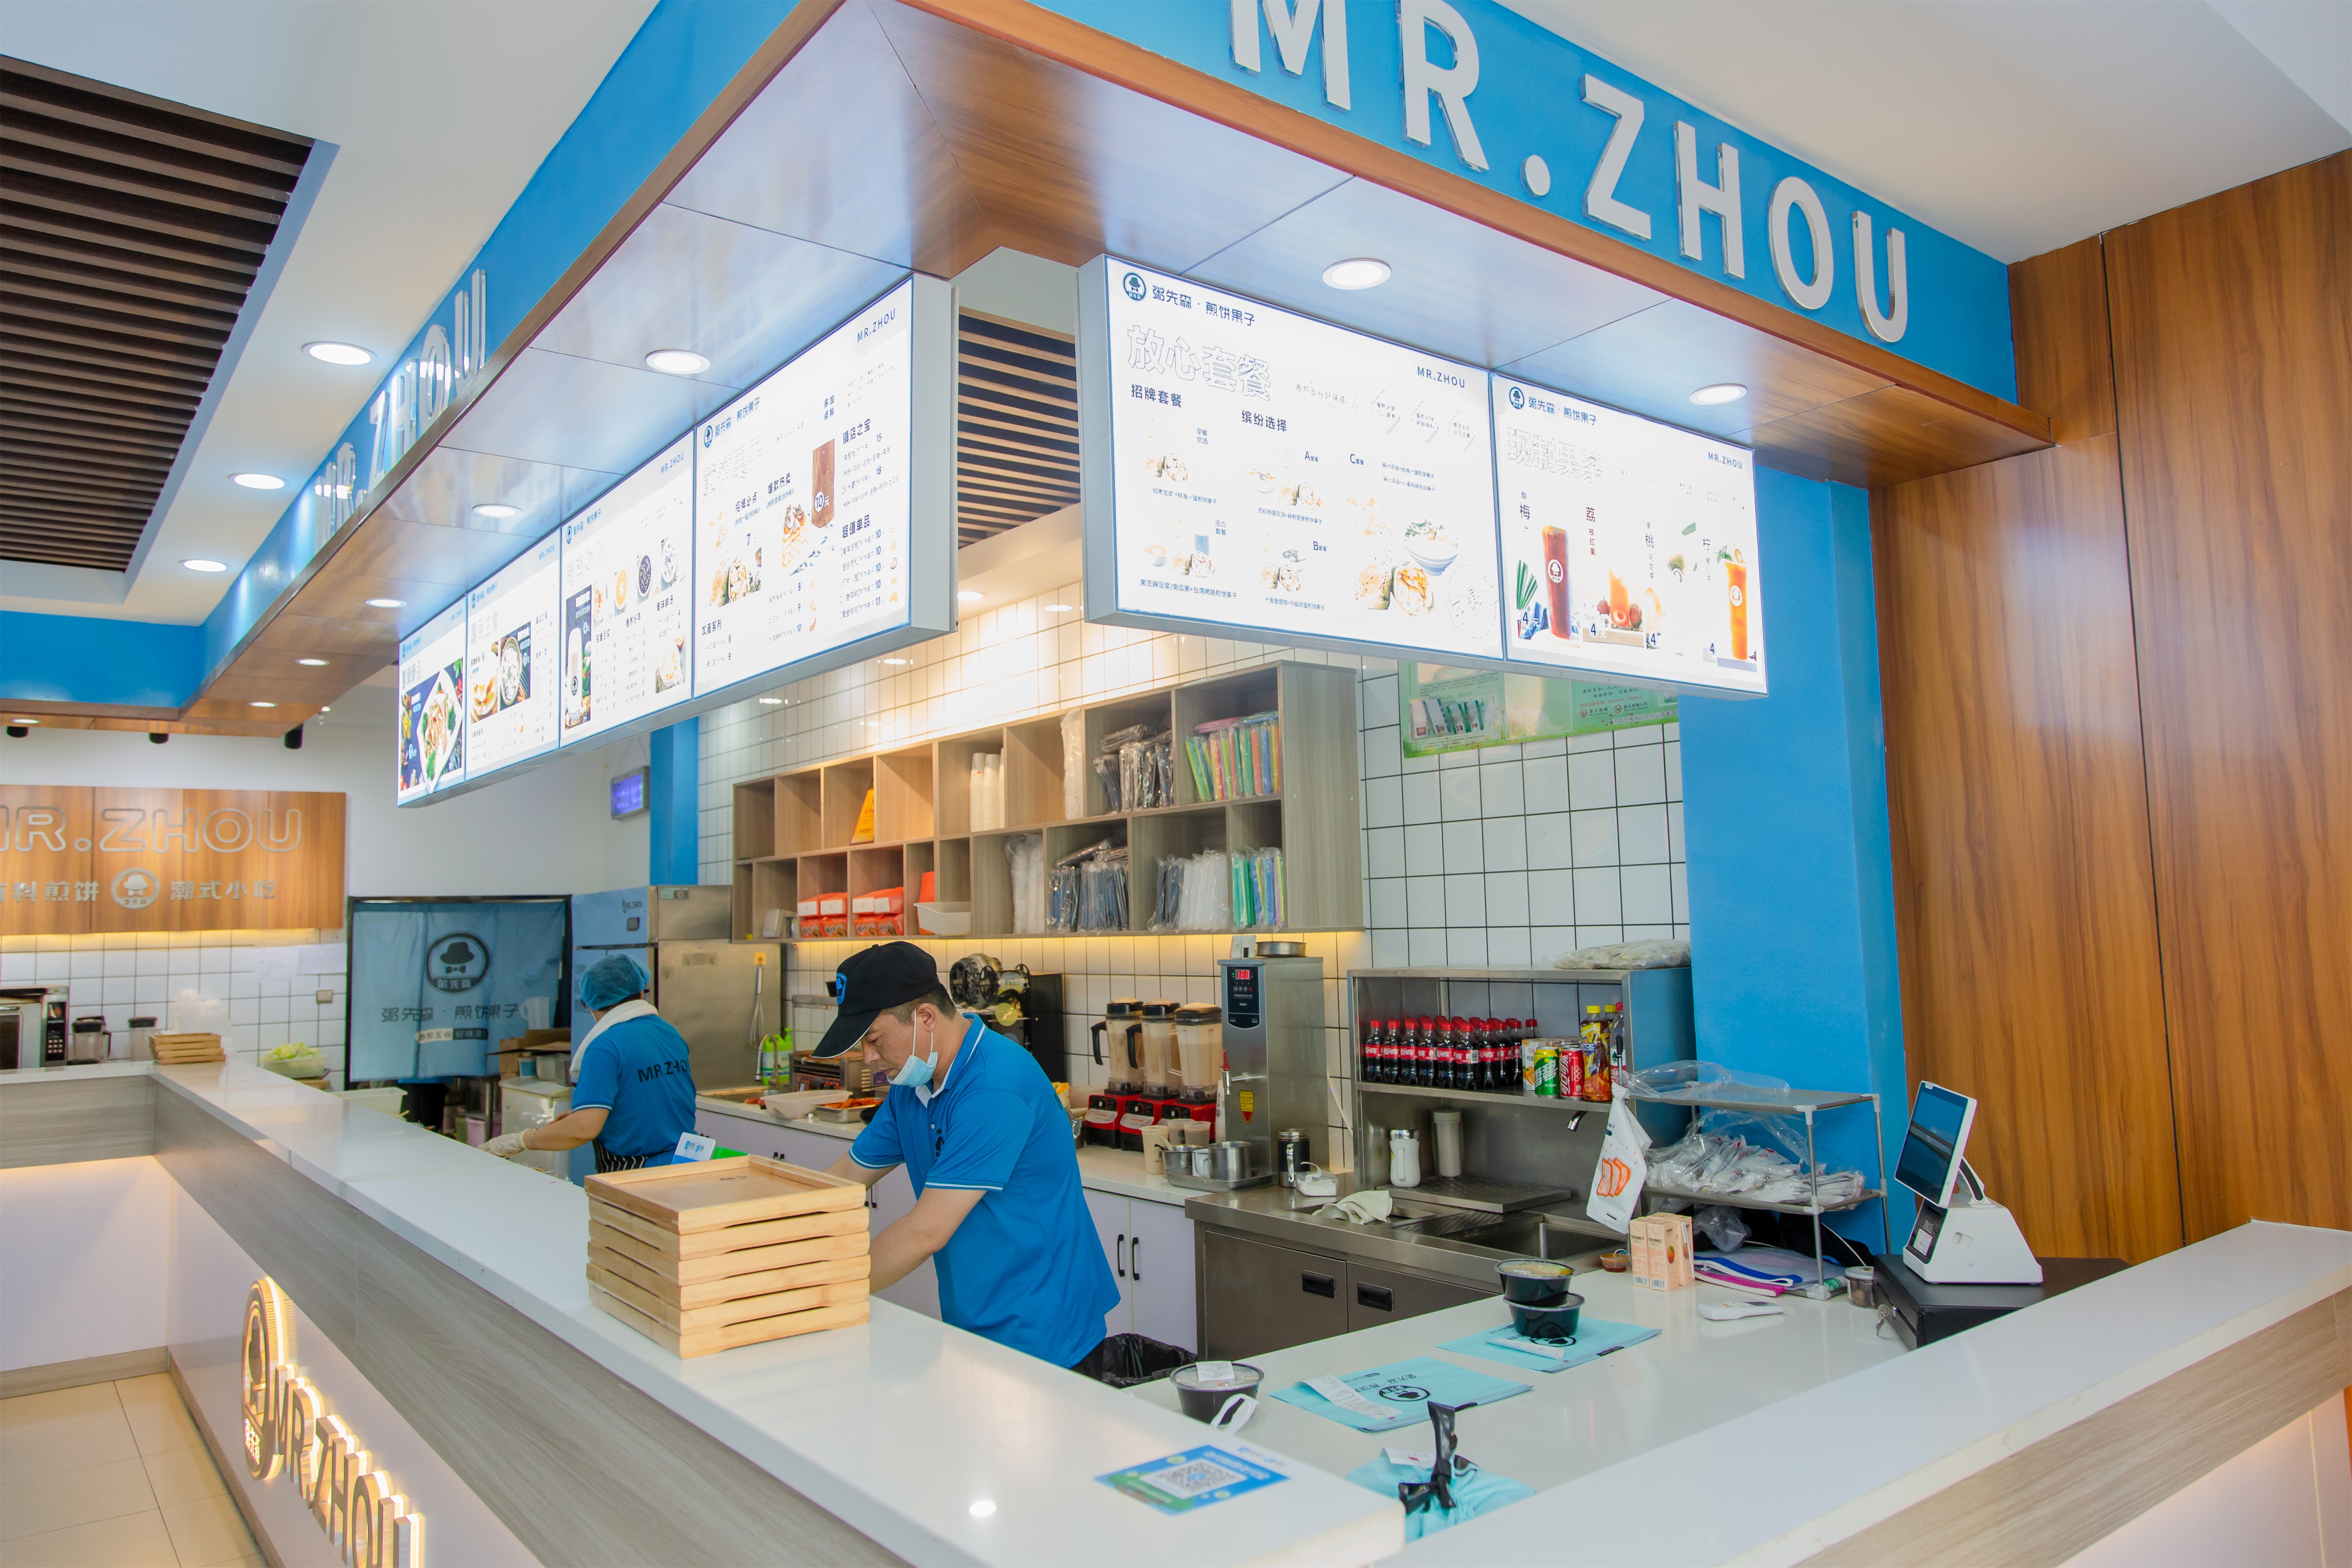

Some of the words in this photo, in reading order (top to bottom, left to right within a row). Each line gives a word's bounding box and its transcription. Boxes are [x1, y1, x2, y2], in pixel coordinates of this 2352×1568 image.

[1227, 0, 1908, 343] MR.ZHOU
[857, 308, 895, 343] MR.ZHOU
[1127, 324, 1272, 402] 放心套餐
[1417, 367, 1465, 388] MR.ZHOU
[1131, 383, 1182, 408] 招牌套餐
[843, 418, 870, 444] 镇店之宝
[1242, 410, 1287, 433] 缤纷选择
[877, 433, 882, 442] 15
[1197, 428, 1208, 437] 早餐
[1197, 436, 1208, 445] 优选
[661, 452, 684, 474] MR.ZHOU
[1708, 452, 1742, 469] MR.ZHOU
[876, 466, 882, 476] 18
[815, 495, 830, 509] 10元
[843, 514, 870, 538] 超值单品
[1215, 519, 1226, 528] 活力
[1215, 527, 1226, 536] 套餐
[1586, 506, 1595, 555] 荔枝红果
[876, 529, 881, 539] 10
[876, 546, 881, 555] 10
[876, 563, 881, 572] 10
[876, 580, 881, 589] 10
[1651, 633, 1656, 645] 4
[1710, 643, 1715, 654] 4
[0, 804, 301, 854] R.ZHOU
[0, 881, 100, 903] 料煎饼
[170, 880, 277, 901] 潮式小吃
[1237, 970, 1250, 980] 100
[1535, 1059, 1558, 1089] 雪碧
[1561, 1055, 1571, 1095] 可口可乐
